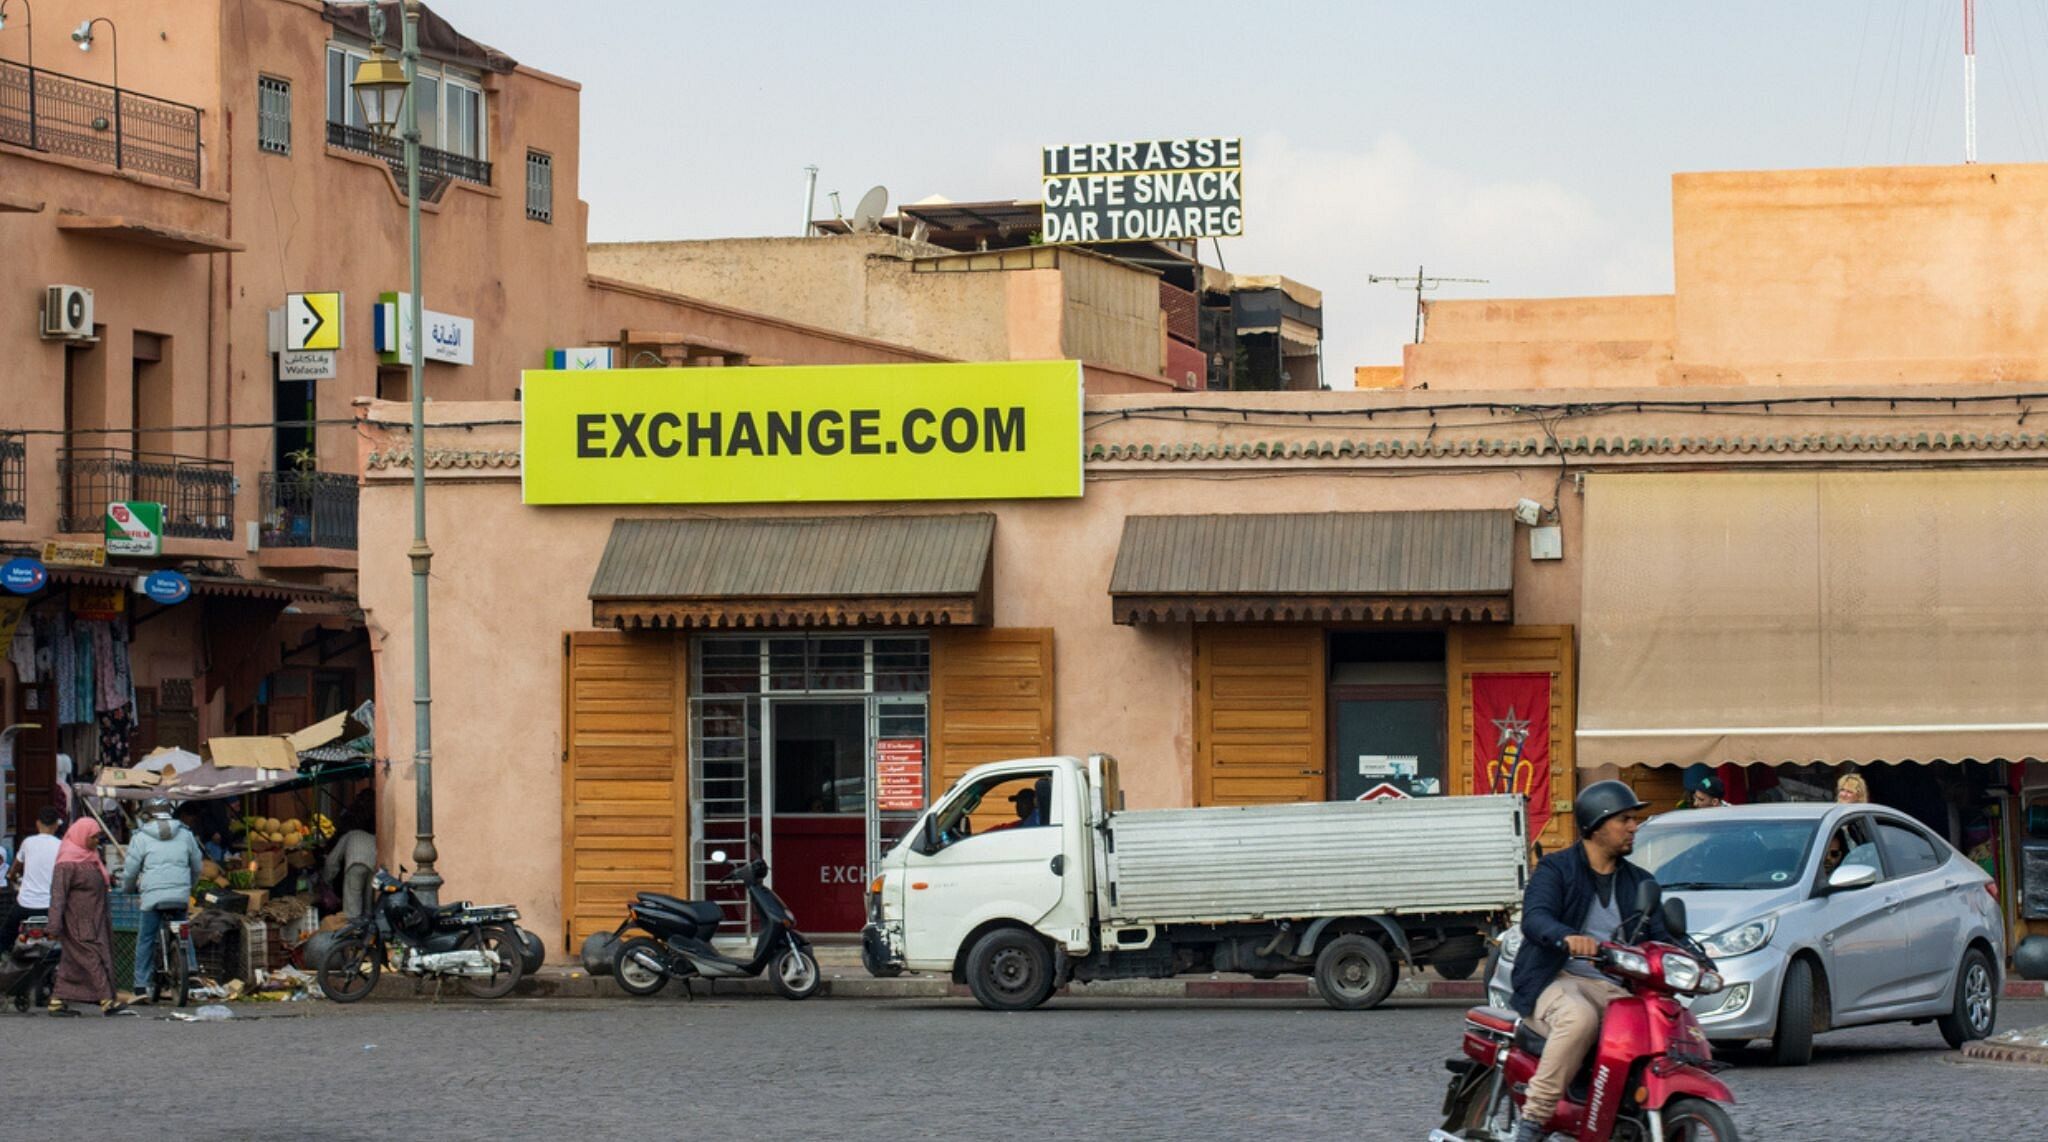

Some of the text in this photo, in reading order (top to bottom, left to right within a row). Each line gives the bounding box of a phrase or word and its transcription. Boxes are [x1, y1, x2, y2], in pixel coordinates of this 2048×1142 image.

[1044, 138, 1240, 173] TERRASSE
[1043, 170, 1240, 208] CAFE SNACK
[1043, 205, 1241, 243] DAR TOUAREG
[285, 366, 328, 375] Wafacash
[576, 407, 1026, 458] EXCHANGE.COM
[13, 567, 32, 575] Maroc
[156, 579, 176, 587] Maroc
